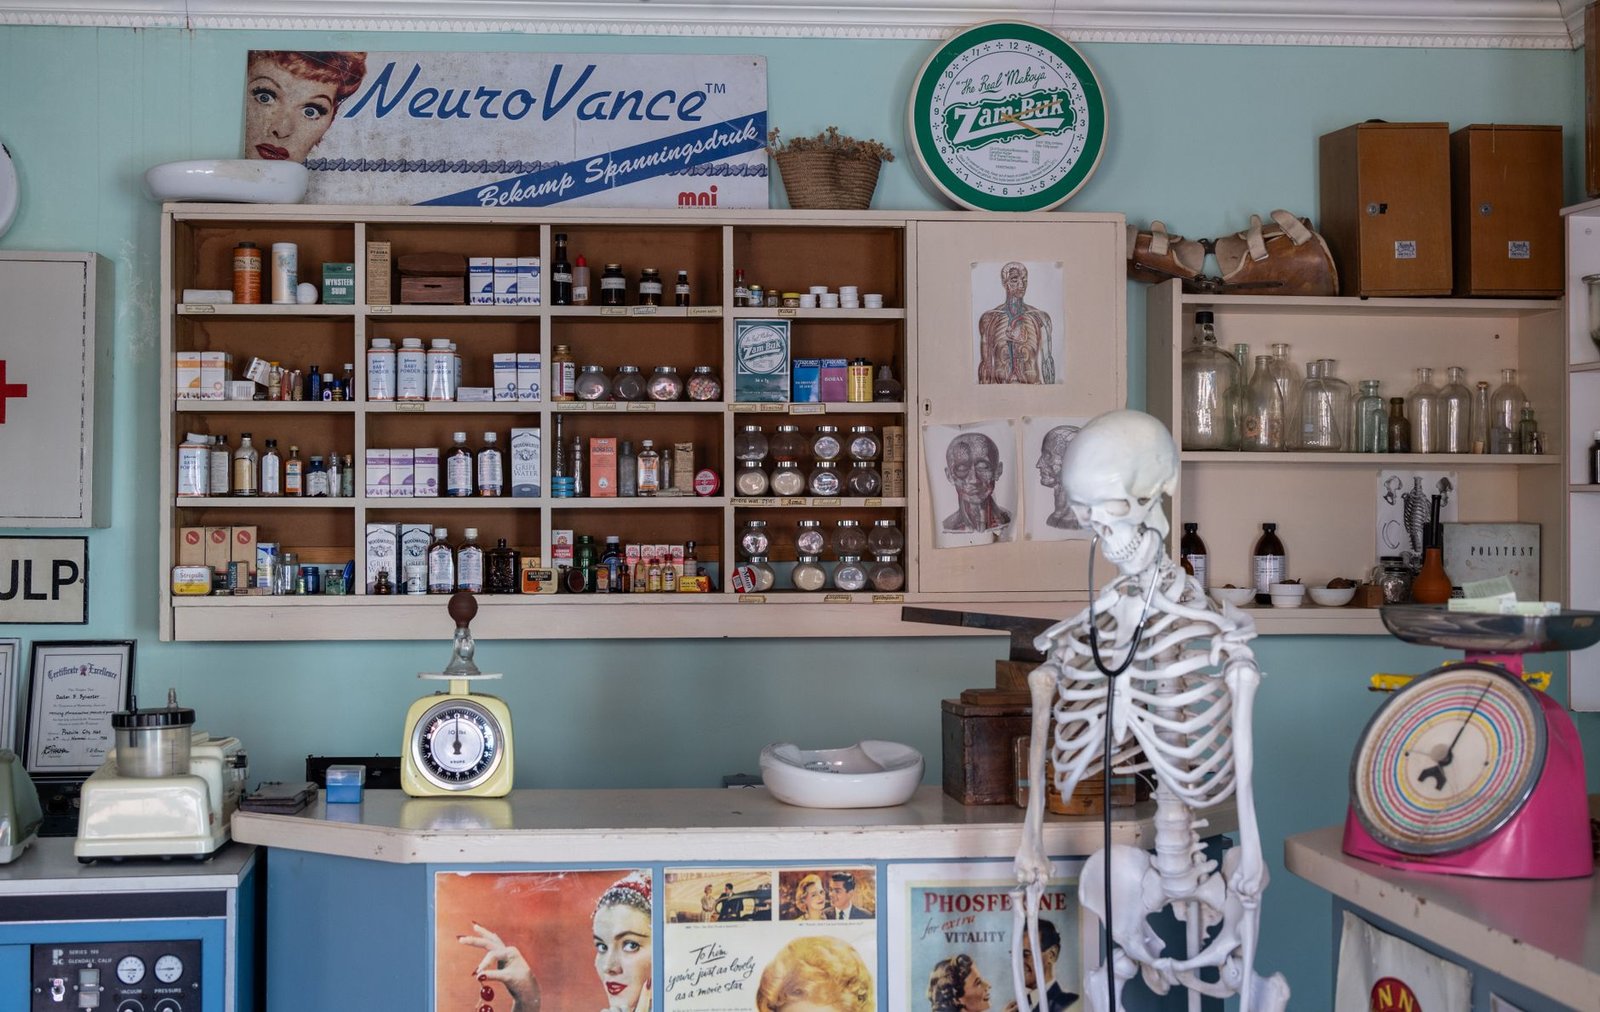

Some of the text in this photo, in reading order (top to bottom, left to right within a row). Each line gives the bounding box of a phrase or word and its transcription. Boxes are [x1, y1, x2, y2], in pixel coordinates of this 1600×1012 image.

[1009, 42, 1019, 50] 12
[945, 71, 953, 79] 10
[978, 72, 1003, 94] Real
[342, 61, 708, 122] NeuroVance
[1080, 119, 1085, 127] 3
[941, 146, 946, 154] 8
[478, 125, 759, 207] Bekamp Spanningsdruk
[963, 173, 969, 181] 7
[678, 185, 718, 206] mni
[1002, 188, 1008, 196] 6
[513, 469, 538, 477] WATER
[1471, 546, 1533, 557] POLYTEST
[47, 662, 118, 682] Certificate Excellence
[923, 891, 1067, 913] PHOSFENE
[920, 914, 976, 940] for extra
[944, 931, 1006, 943] VITALITY
[689, 942, 727, 965] To him
[665, 956, 756, 992] you're just as lovely
[675, 979, 744, 1001] as a movie star
